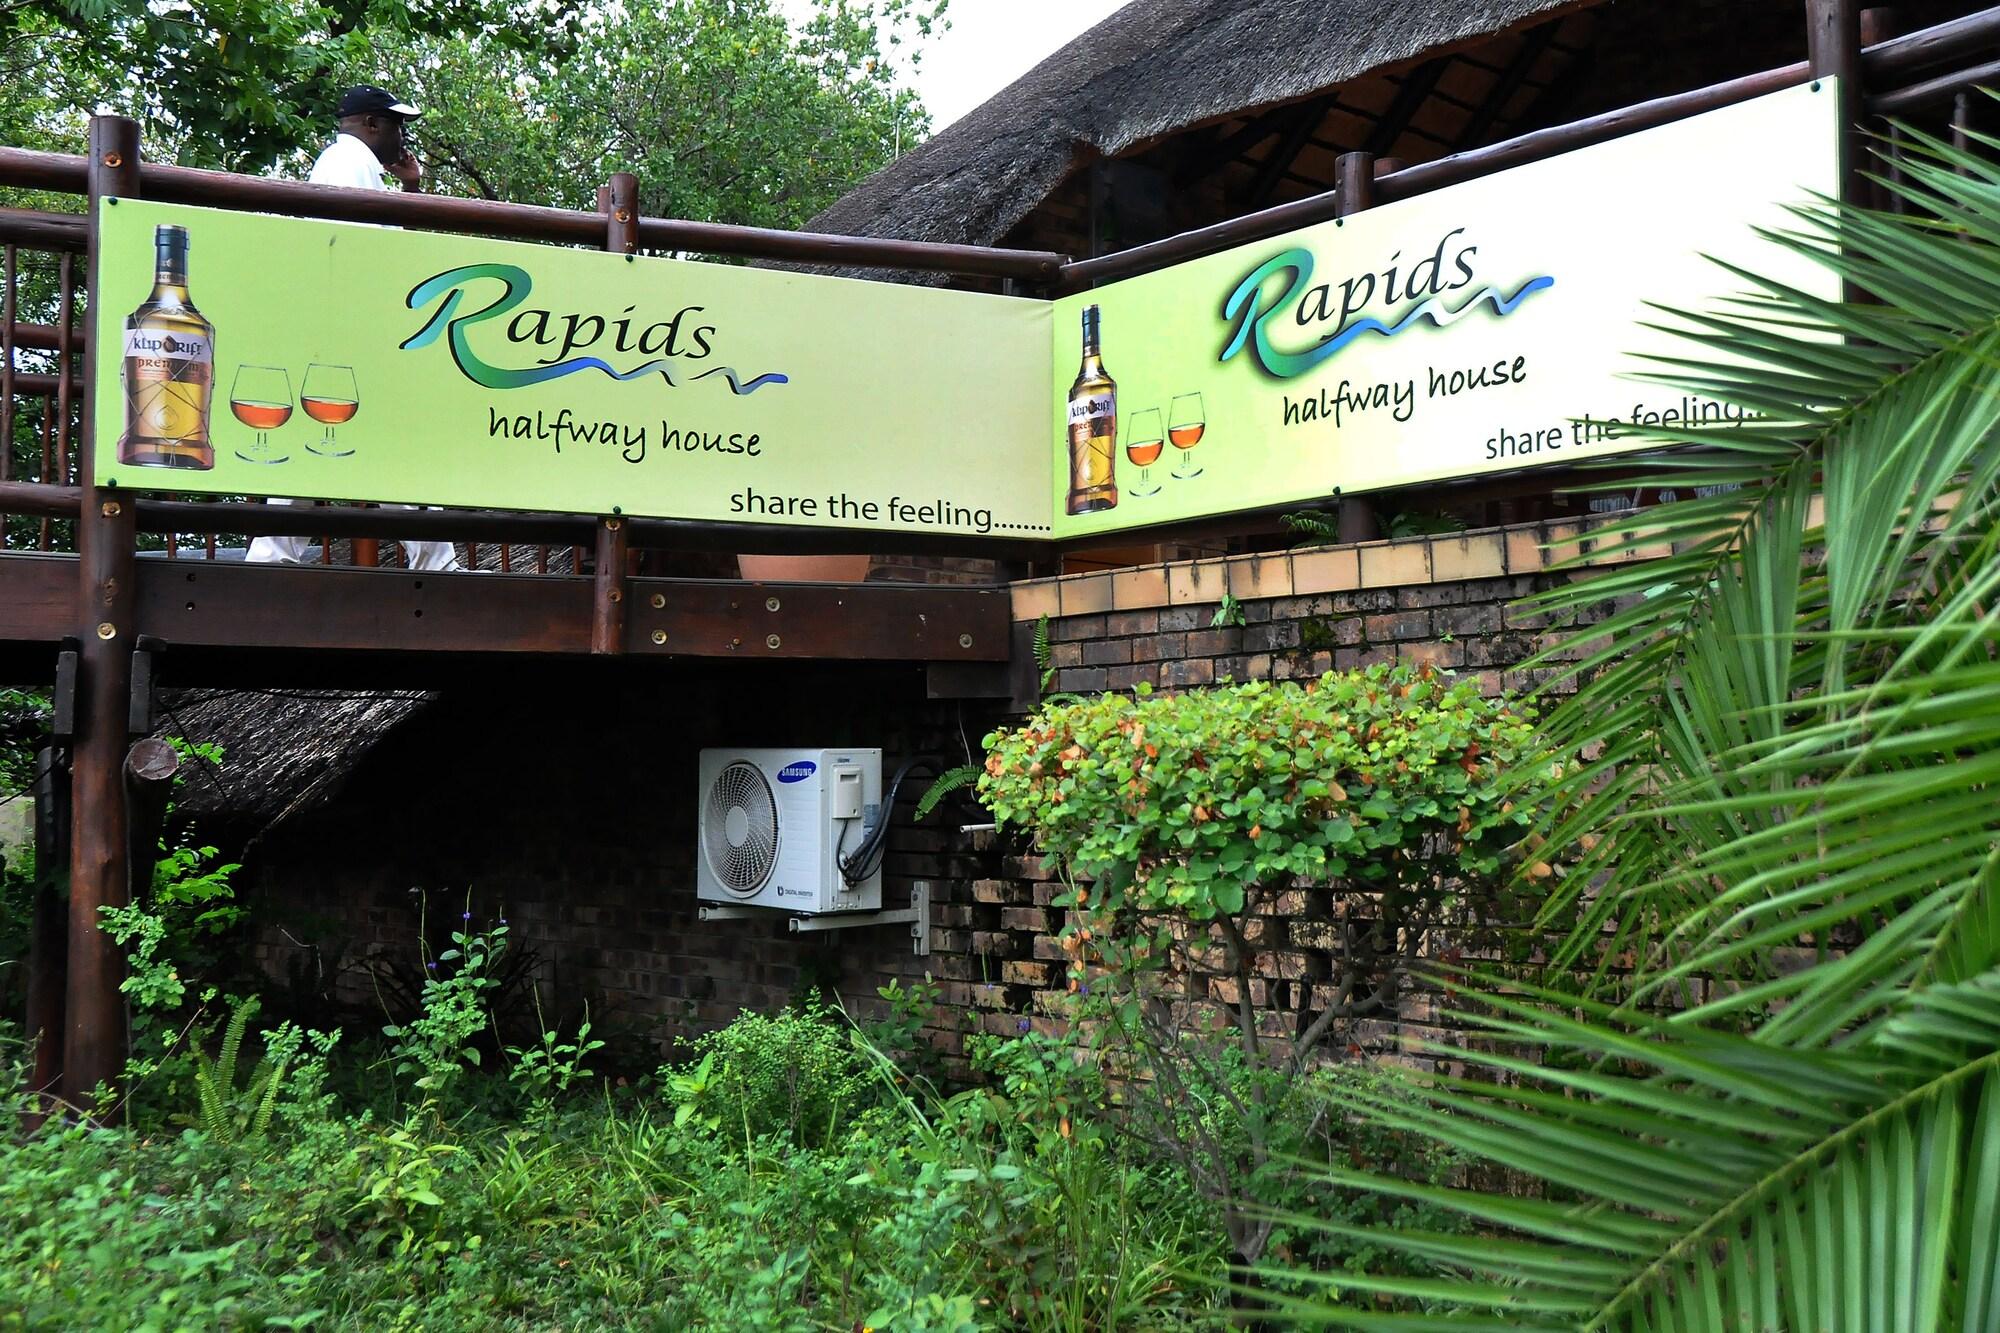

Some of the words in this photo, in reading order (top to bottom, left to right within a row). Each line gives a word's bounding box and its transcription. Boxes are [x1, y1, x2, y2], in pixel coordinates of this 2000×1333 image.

[399, 263, 716, 389] Rapids
[1218, 227, 1477, 378] Rapids
[1284, 380, 1413, 428] halfway
[1428, 356, 1527, 398] house
[489, 407, 646, 463] halfway
[662, 420, 762, 457] house
[1486, 427, 1563, 460] share
[1571, 413, 1622, 446] the
[730, 487, 817, 517] share
[827, 493, 879, 521] the
[781, 767, 813, 777] SAMSUNG
